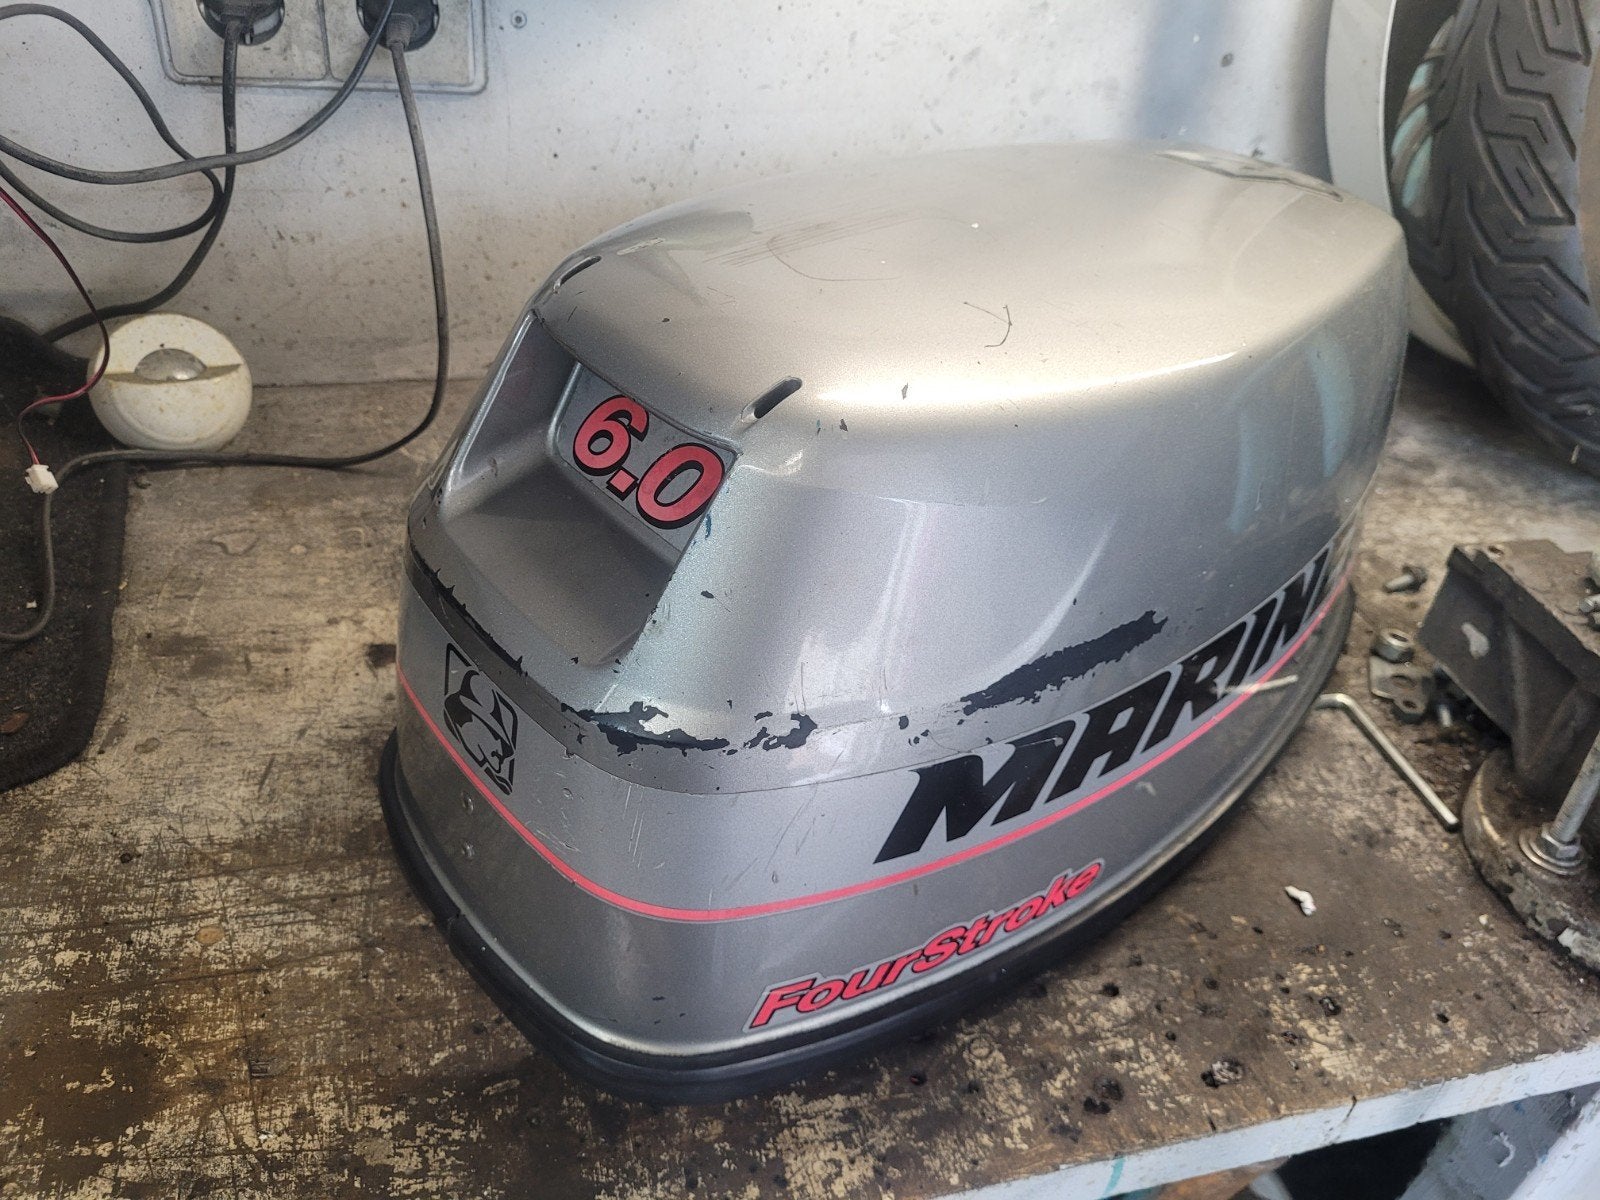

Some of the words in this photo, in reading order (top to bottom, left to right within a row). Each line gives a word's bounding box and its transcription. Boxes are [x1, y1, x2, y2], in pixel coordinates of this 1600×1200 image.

[573, 395, 725, 529] 6.0
[873, 547, 1331, 865] MARIN
[749, 862, 1102, 1029] FourStroke
